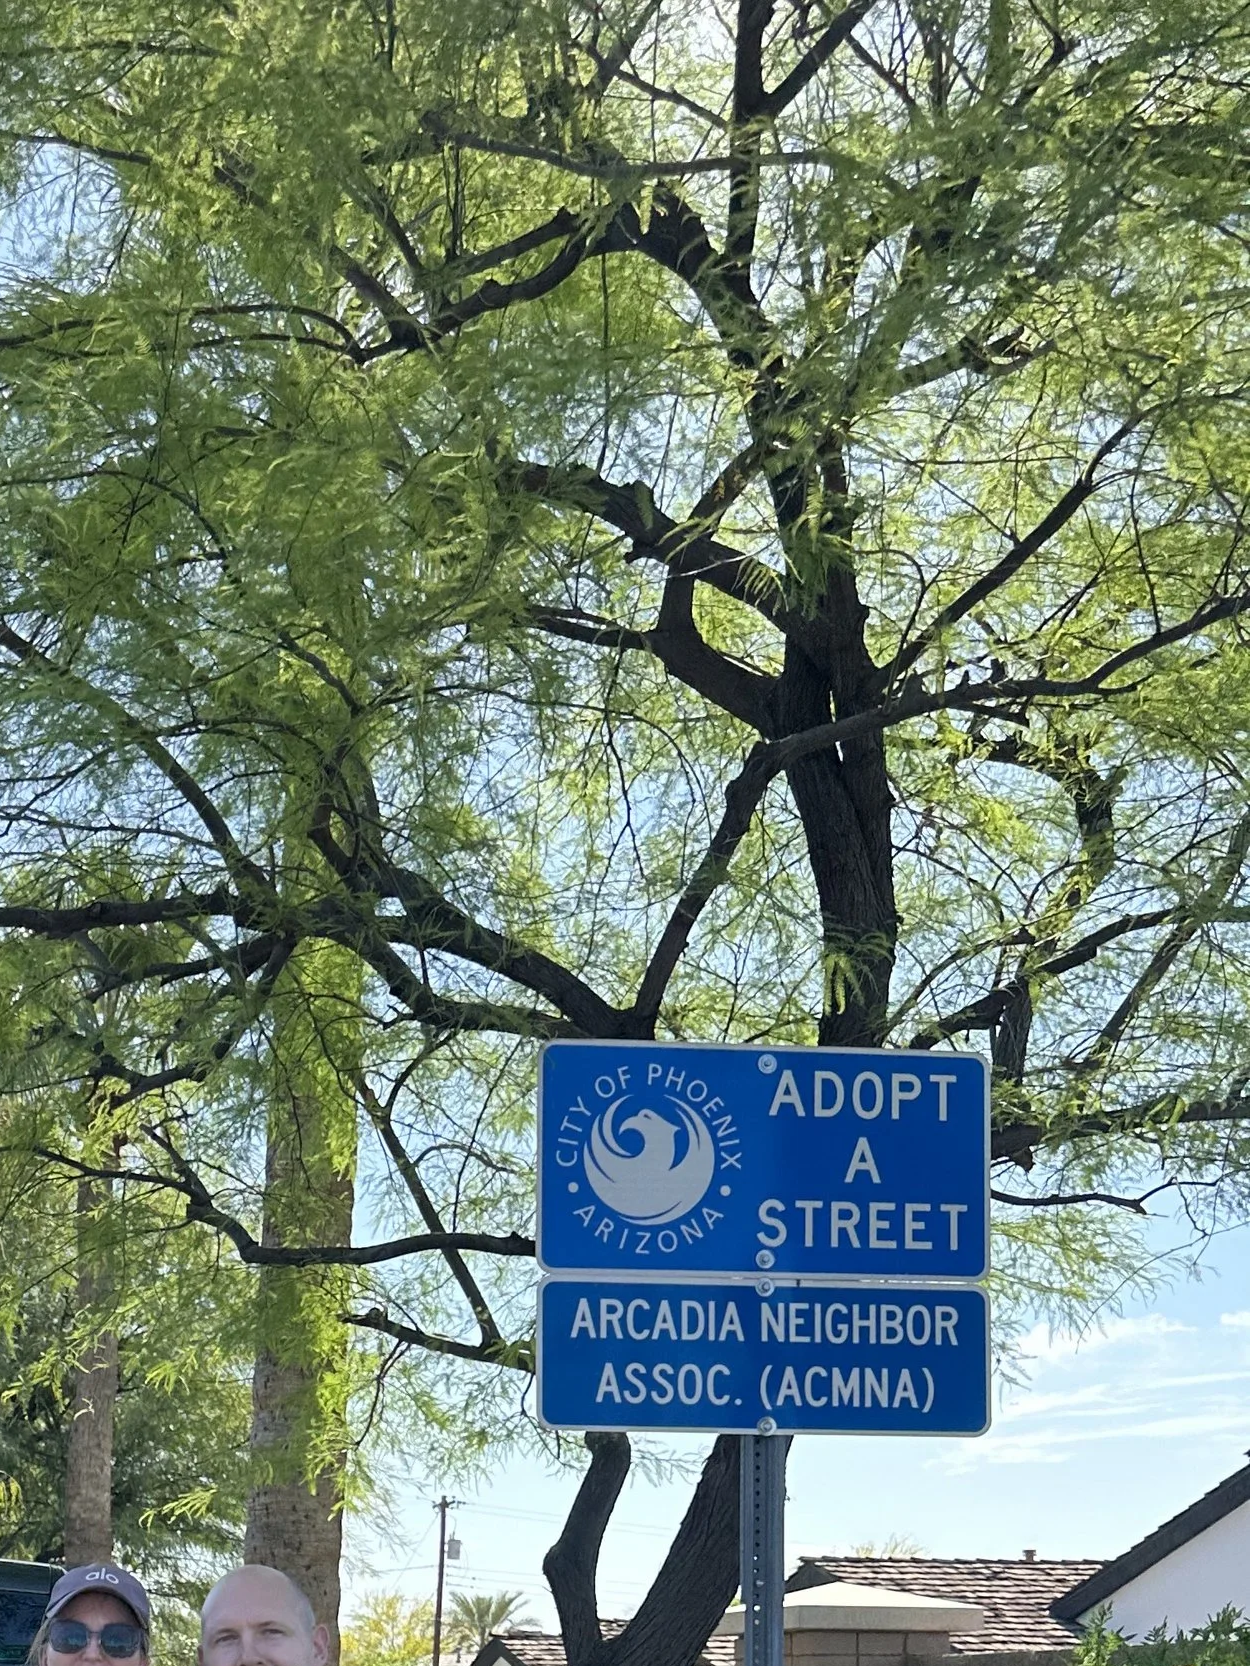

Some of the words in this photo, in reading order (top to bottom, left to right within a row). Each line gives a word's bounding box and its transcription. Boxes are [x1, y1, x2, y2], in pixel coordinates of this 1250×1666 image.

[555, 1096, 592, 1167] CITY
[594, 1065, 631, 1098] OF
[647, 1063, 742, 1170] PHOENIX
[768, 1069, 957, 1121] ADOPT
[844, 1136, 881, 1183] A
[572, 1204, 725, 1255] ARIZONA
[756, 1198, 968, 1251] STREET
[570, 1297, 745, 1342] ARCADIA
[760, 1302, 959, 1346] NEIGHBOR
[595, 1362, 743, 1407] ASSOC.
[759, 1365, 935, 1414] (ACMNA)
[85, 1567, 119, 1585] alo
